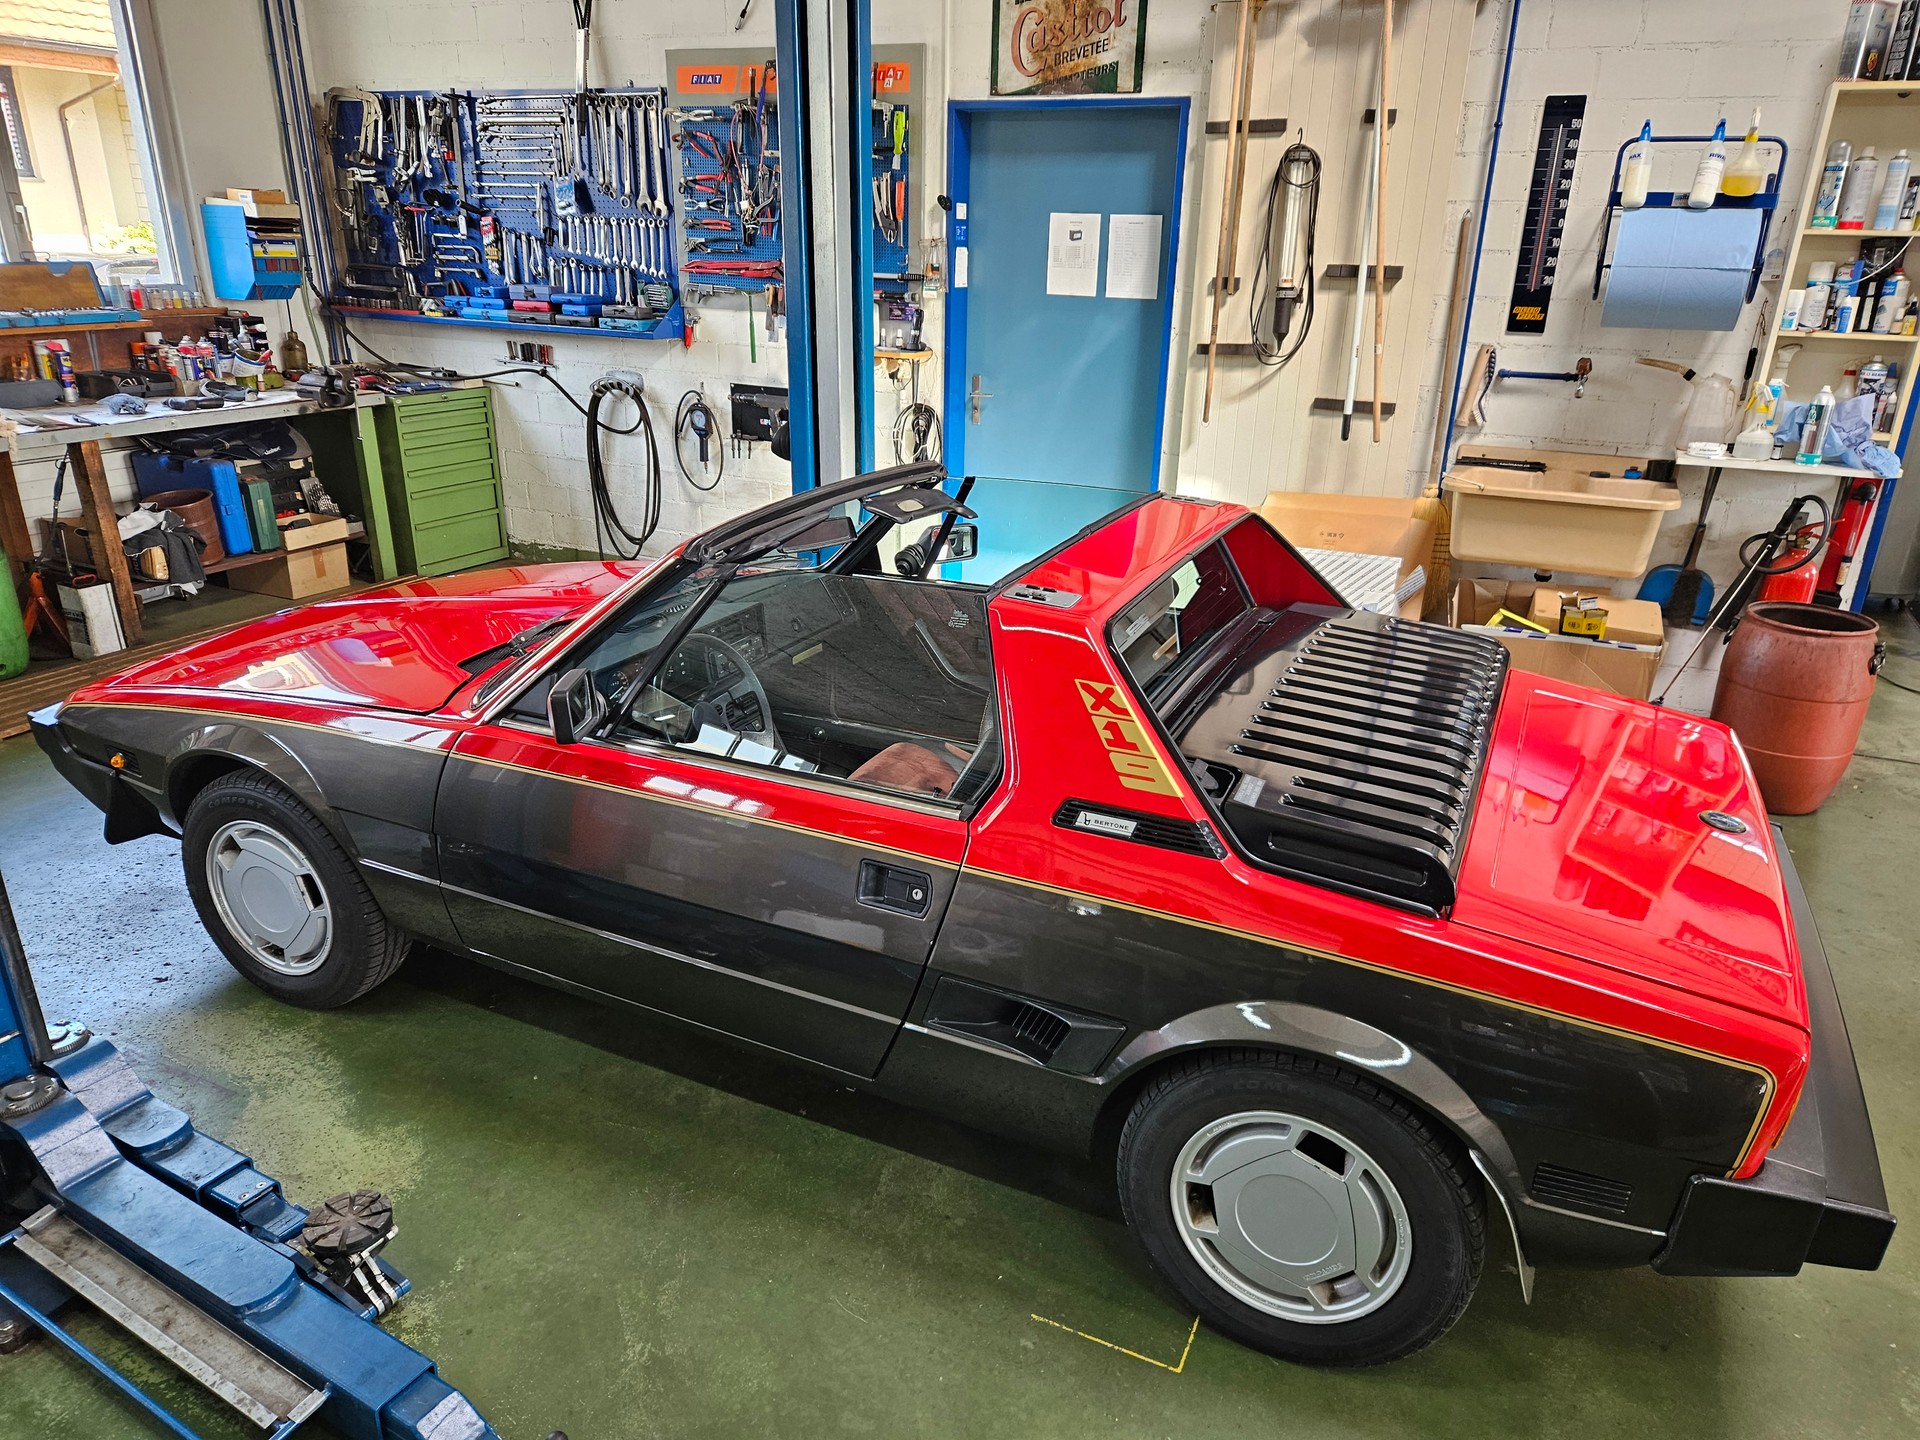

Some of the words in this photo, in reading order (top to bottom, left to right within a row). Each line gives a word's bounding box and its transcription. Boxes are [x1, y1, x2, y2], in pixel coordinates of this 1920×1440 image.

[692, 75, 721, 84] FIAT
[1571, 118, 1583, 129] 50
[1567, 139, 1579, 149] 40
[1563, 159, 1575, 169] 30
[1560, 179, 1571, 189] 20
[1559, 198, 1568, 209] 10
[1558, 218, 1564, 228] 0
[1552, 237, 1561, 247] 10
[1546, 257, 1557, 267] 20
[1543, 275, 1554, 285] 30
[208, 796, 264, 809] COMFORT
[1094, 819, 1130, 830] BERTONE
